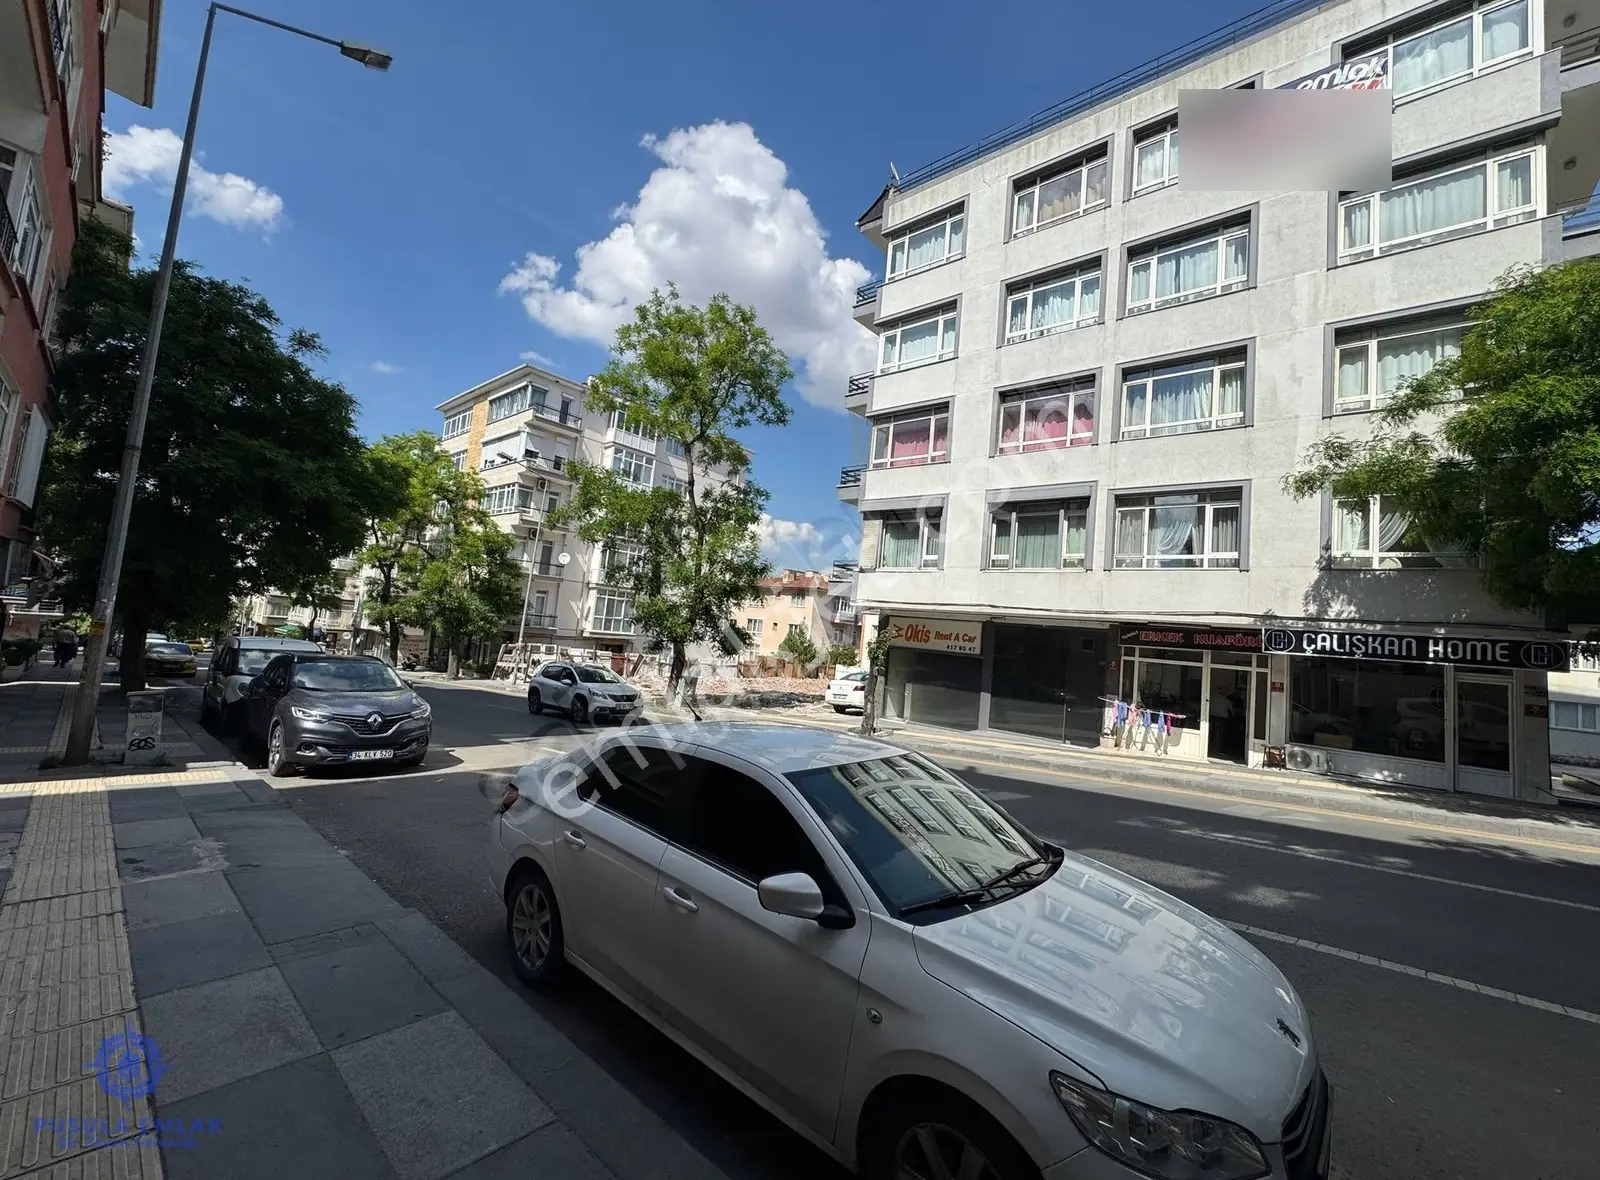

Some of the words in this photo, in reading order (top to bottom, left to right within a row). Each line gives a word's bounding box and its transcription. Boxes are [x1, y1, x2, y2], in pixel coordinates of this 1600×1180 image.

[904, 623, 931, 643] Okis
[934, 631, 953, 641] Rent
[953, 632, 960, 642] A
[961, 633, 977, 643] Car
[1140, 630, 1184, 643] ERKEK
[1302, 632, 1417, 657] ÇALIŞKAN
[1428, 639, 1510, 662] HOME
